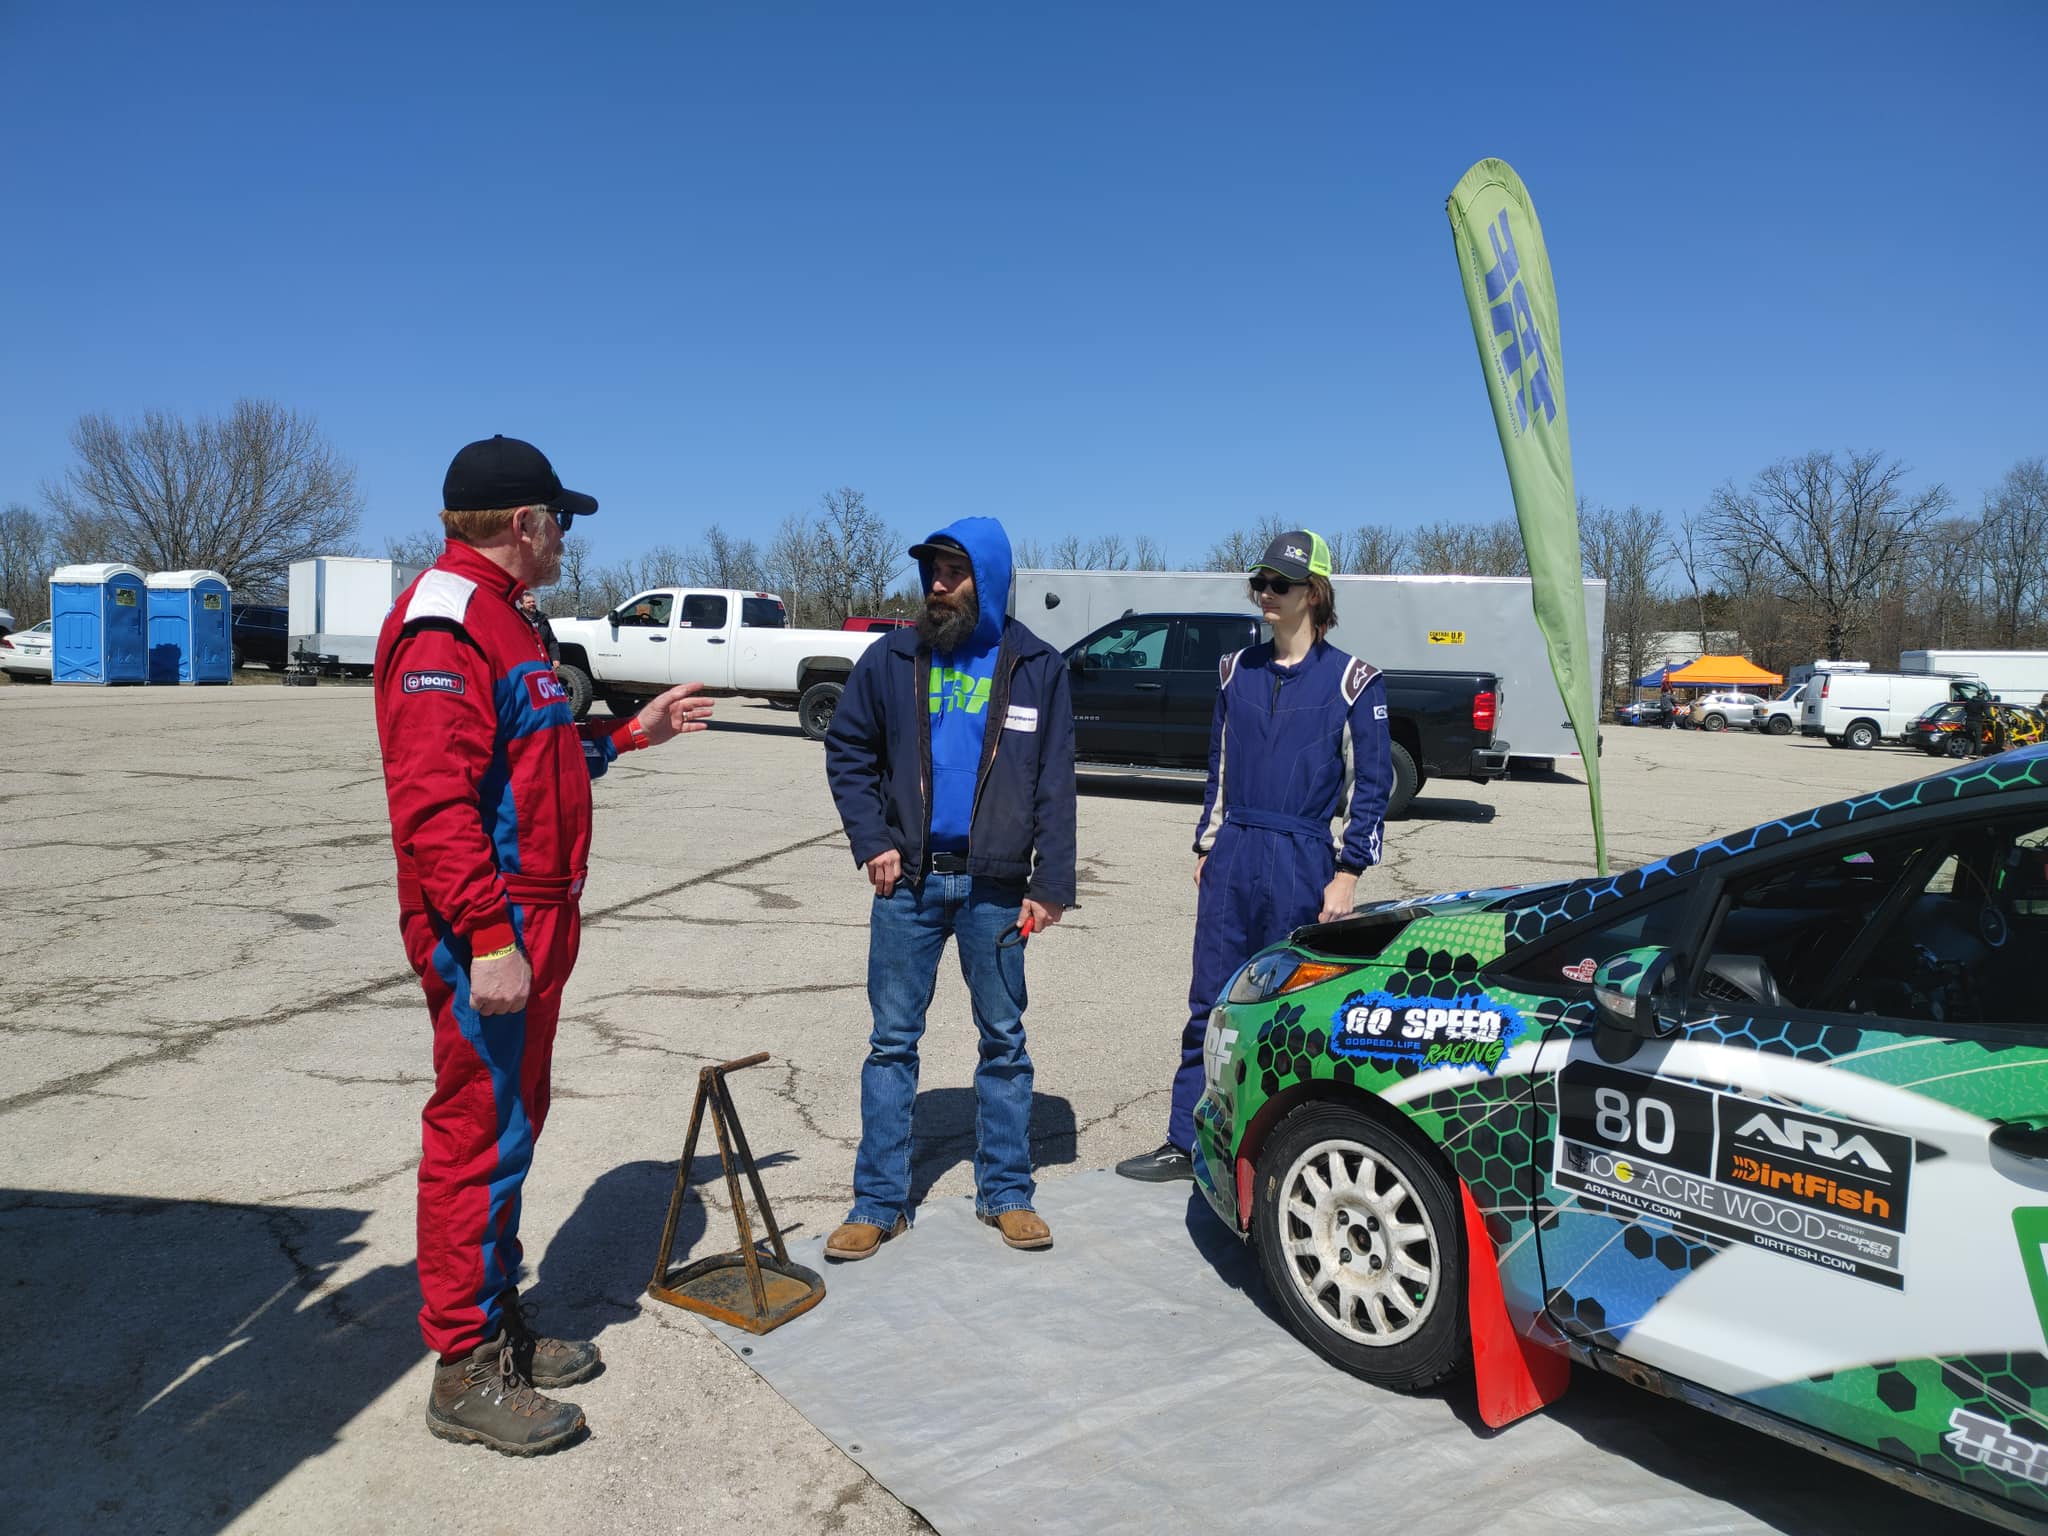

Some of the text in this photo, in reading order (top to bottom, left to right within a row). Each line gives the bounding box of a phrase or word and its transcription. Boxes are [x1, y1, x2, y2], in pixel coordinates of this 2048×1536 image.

[1346, 1007, 1501, 1042] GO SPEED
[1345, 1037, 1421, 1050] GOSPEED.LIFE
[1423, 1040, 1504, 1071] RACING
[1595, 1087, 1676, 1154] 80
[1734, 1112, 1893, 1174] ARA
[1584, 1183, 1682, 1220] ARA-RALLY.COM
[1642, 1169, 1715, 1209] ACRE
[1723, 1190, 1826, 1240] WOOD
[1732, 1155, 1890, 1219] DirtFish
[1755, 1235, 1856, 1273] DIRTFISH.COM
[1826, 1229, 1892, 1253] COOPER
